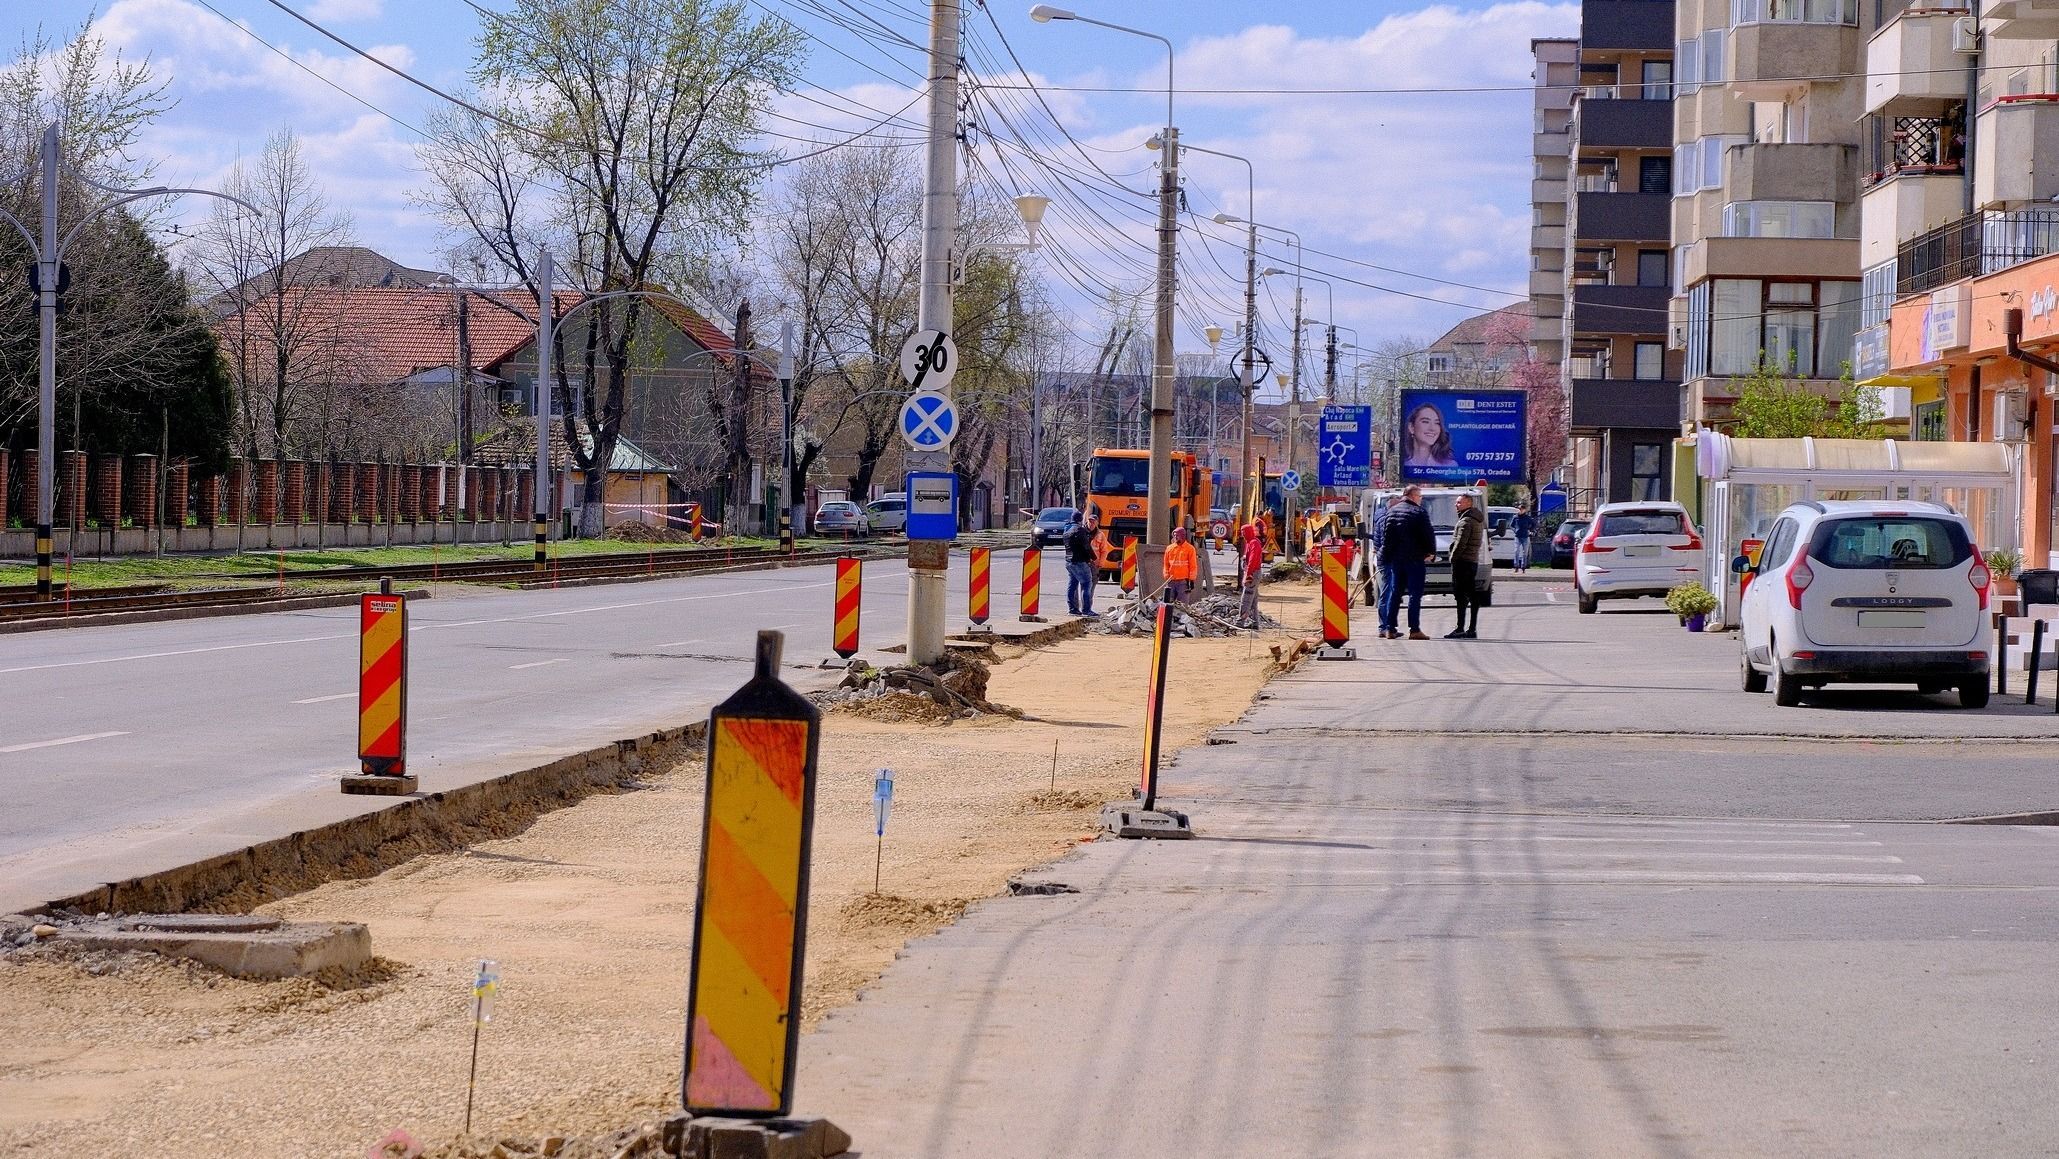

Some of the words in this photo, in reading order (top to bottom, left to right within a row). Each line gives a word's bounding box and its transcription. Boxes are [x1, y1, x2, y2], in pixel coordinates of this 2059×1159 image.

[914, 345, 948, 373] 30
[1466, 453, 1484, 461] 0757
[1484, 453, 1494, 461] 57
[1495, 453, 1505, 461] 37
[1505, 453, 1515, 461] 57
[1426, 468, 1457, 476] Gheorghe
[1215, 527, 1225, 535] 30
